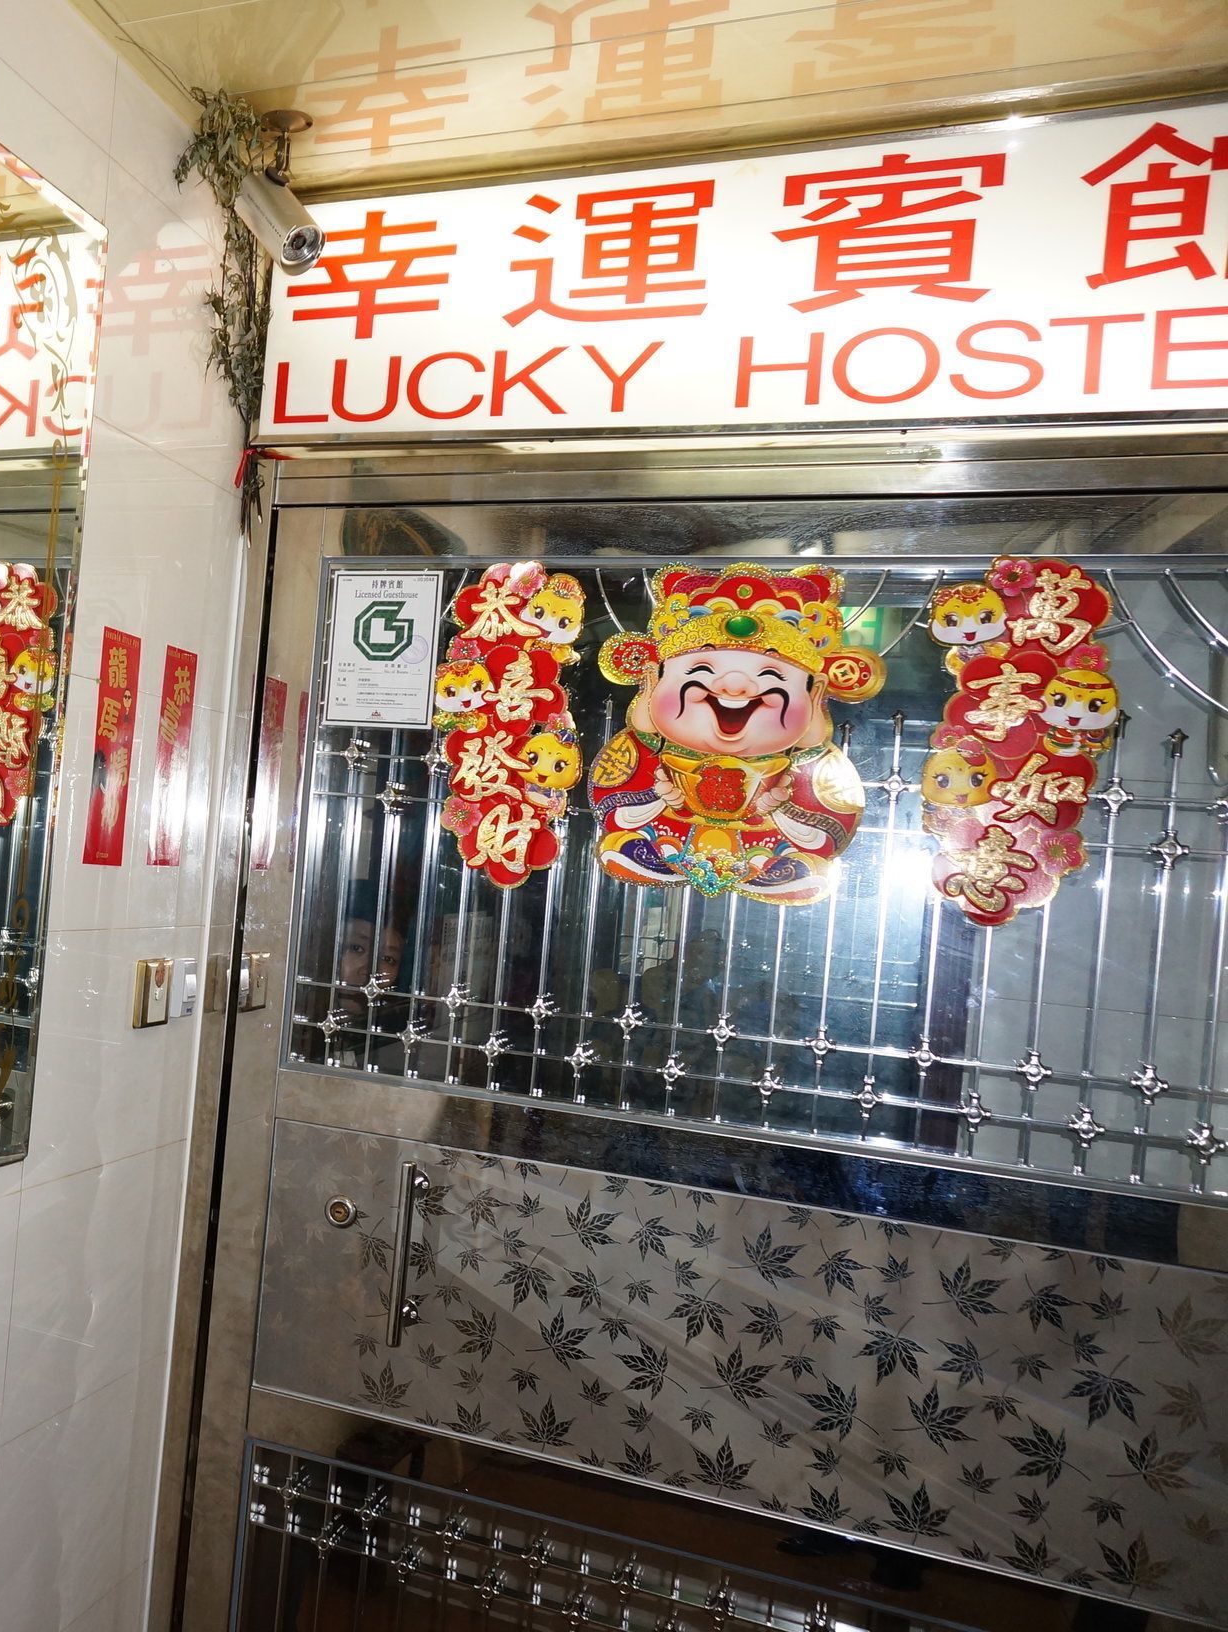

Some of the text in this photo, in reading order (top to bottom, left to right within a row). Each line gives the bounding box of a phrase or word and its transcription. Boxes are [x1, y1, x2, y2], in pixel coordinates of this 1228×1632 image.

[273, 341, 665, 424] LUCKY
[355, 590, 418, 599] Licensed Guesthouse
[452, 580, 554, 874] 恭喜發財
[945, 568, 1092, 913] 萬事如意
